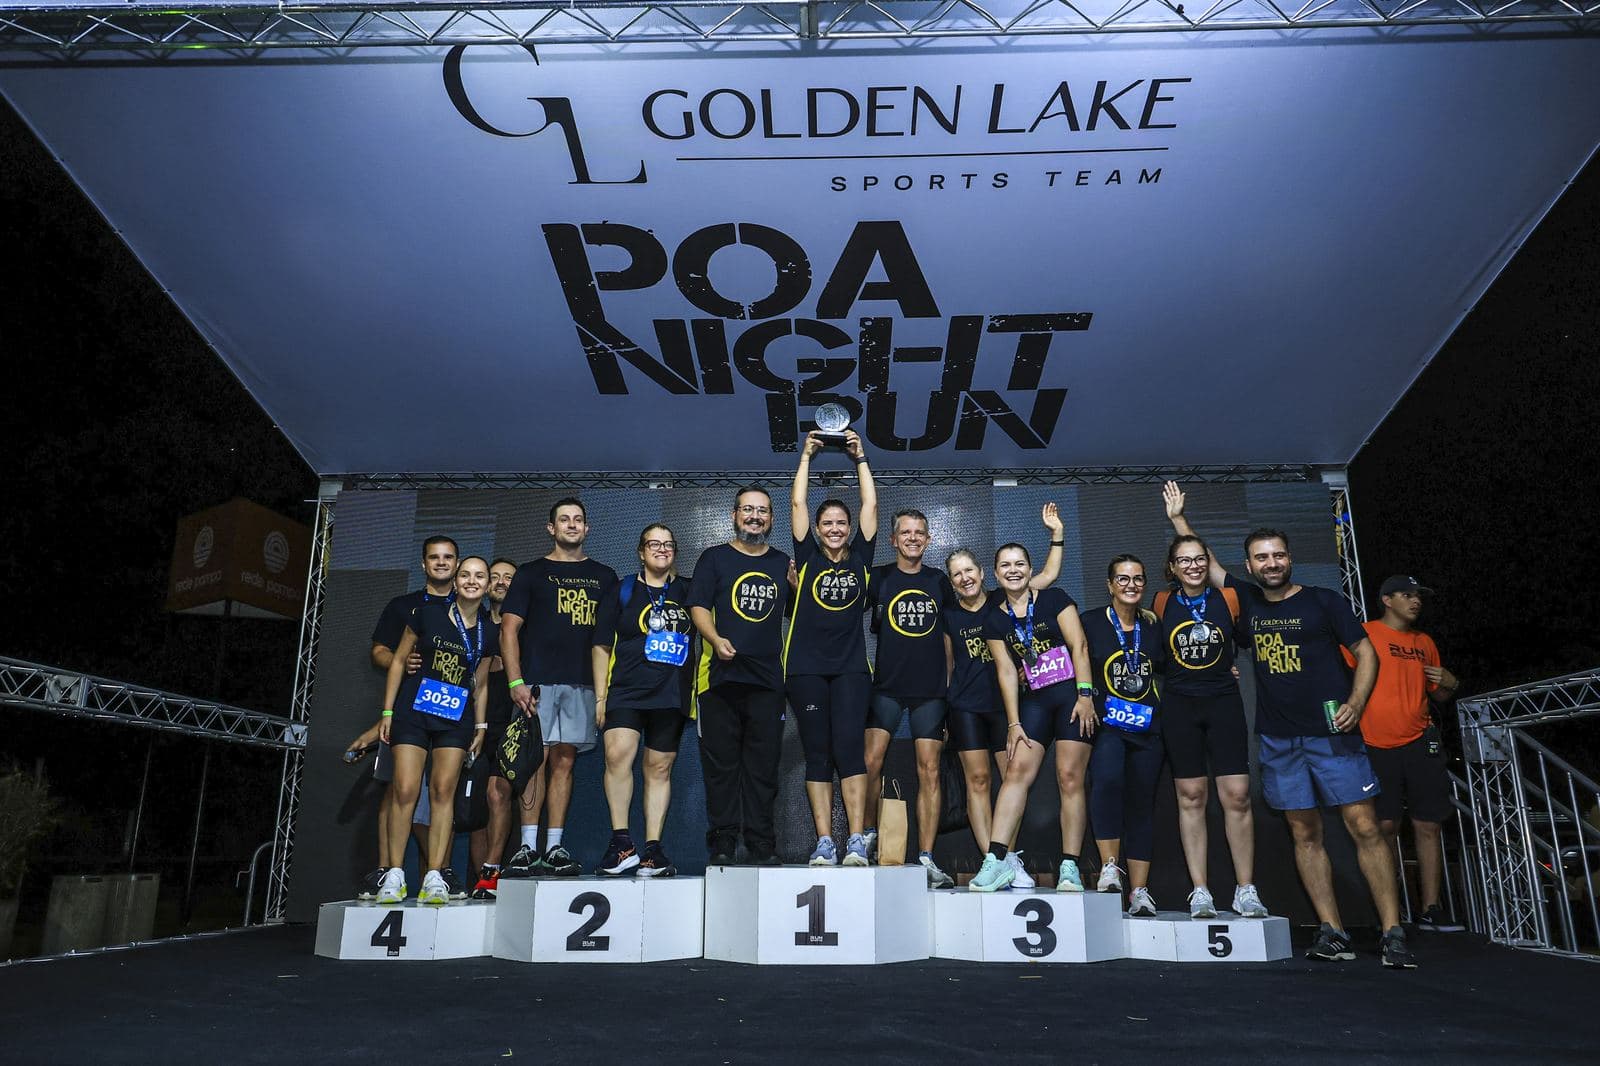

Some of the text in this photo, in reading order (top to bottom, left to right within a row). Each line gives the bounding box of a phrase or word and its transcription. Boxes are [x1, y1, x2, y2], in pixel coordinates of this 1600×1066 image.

[642, 77, 1192, 140] GOLDEN LAKE
[831, 167, 1163, 192] SPORTS TEAM
[541, 220, 942, 322] POA
[575, 312, 1093, 396] NIGHT
[765, 388, 1068, 453] RUN
[822, 574, 857, 588] BASE
[558, 588, 588, 601] POA
[741, 583, 775, 597] BASE
[820, 587, 850, 600] FIT
[558, 600, 598, 613] NIGHT
[740, 597, 766, 611] FIT
[897, 601, 935, 614] BASE
[572, 612, 596, 625] RUN
[898, 613, 926, 627] FIT
[650, 639, 684, 656] 3037
[1254, 632, 1285, 647] POA
[434, 650, 459, 665] POA
[1180, 645, 1209, 660] FIT
[1256, 645, 1300, 662] NIGHT
[1389, 643, 1425, 656] RUN
[432, 661, 466, 677] NIGHT
[1030, 656, 1066, 678] 5447
[1269, 658, 1302, 674] RUN
[421, 689, 460, 709] 3029
[1107, 707, 1146, 728] 3022
[566, 891, 613, 952] 2
[795, 884, 839, 947] 1
[370, 911, 407, 957] 4
[1011, 898, 1058, 958] 3
[1207, 925, 1233, 958] 5
